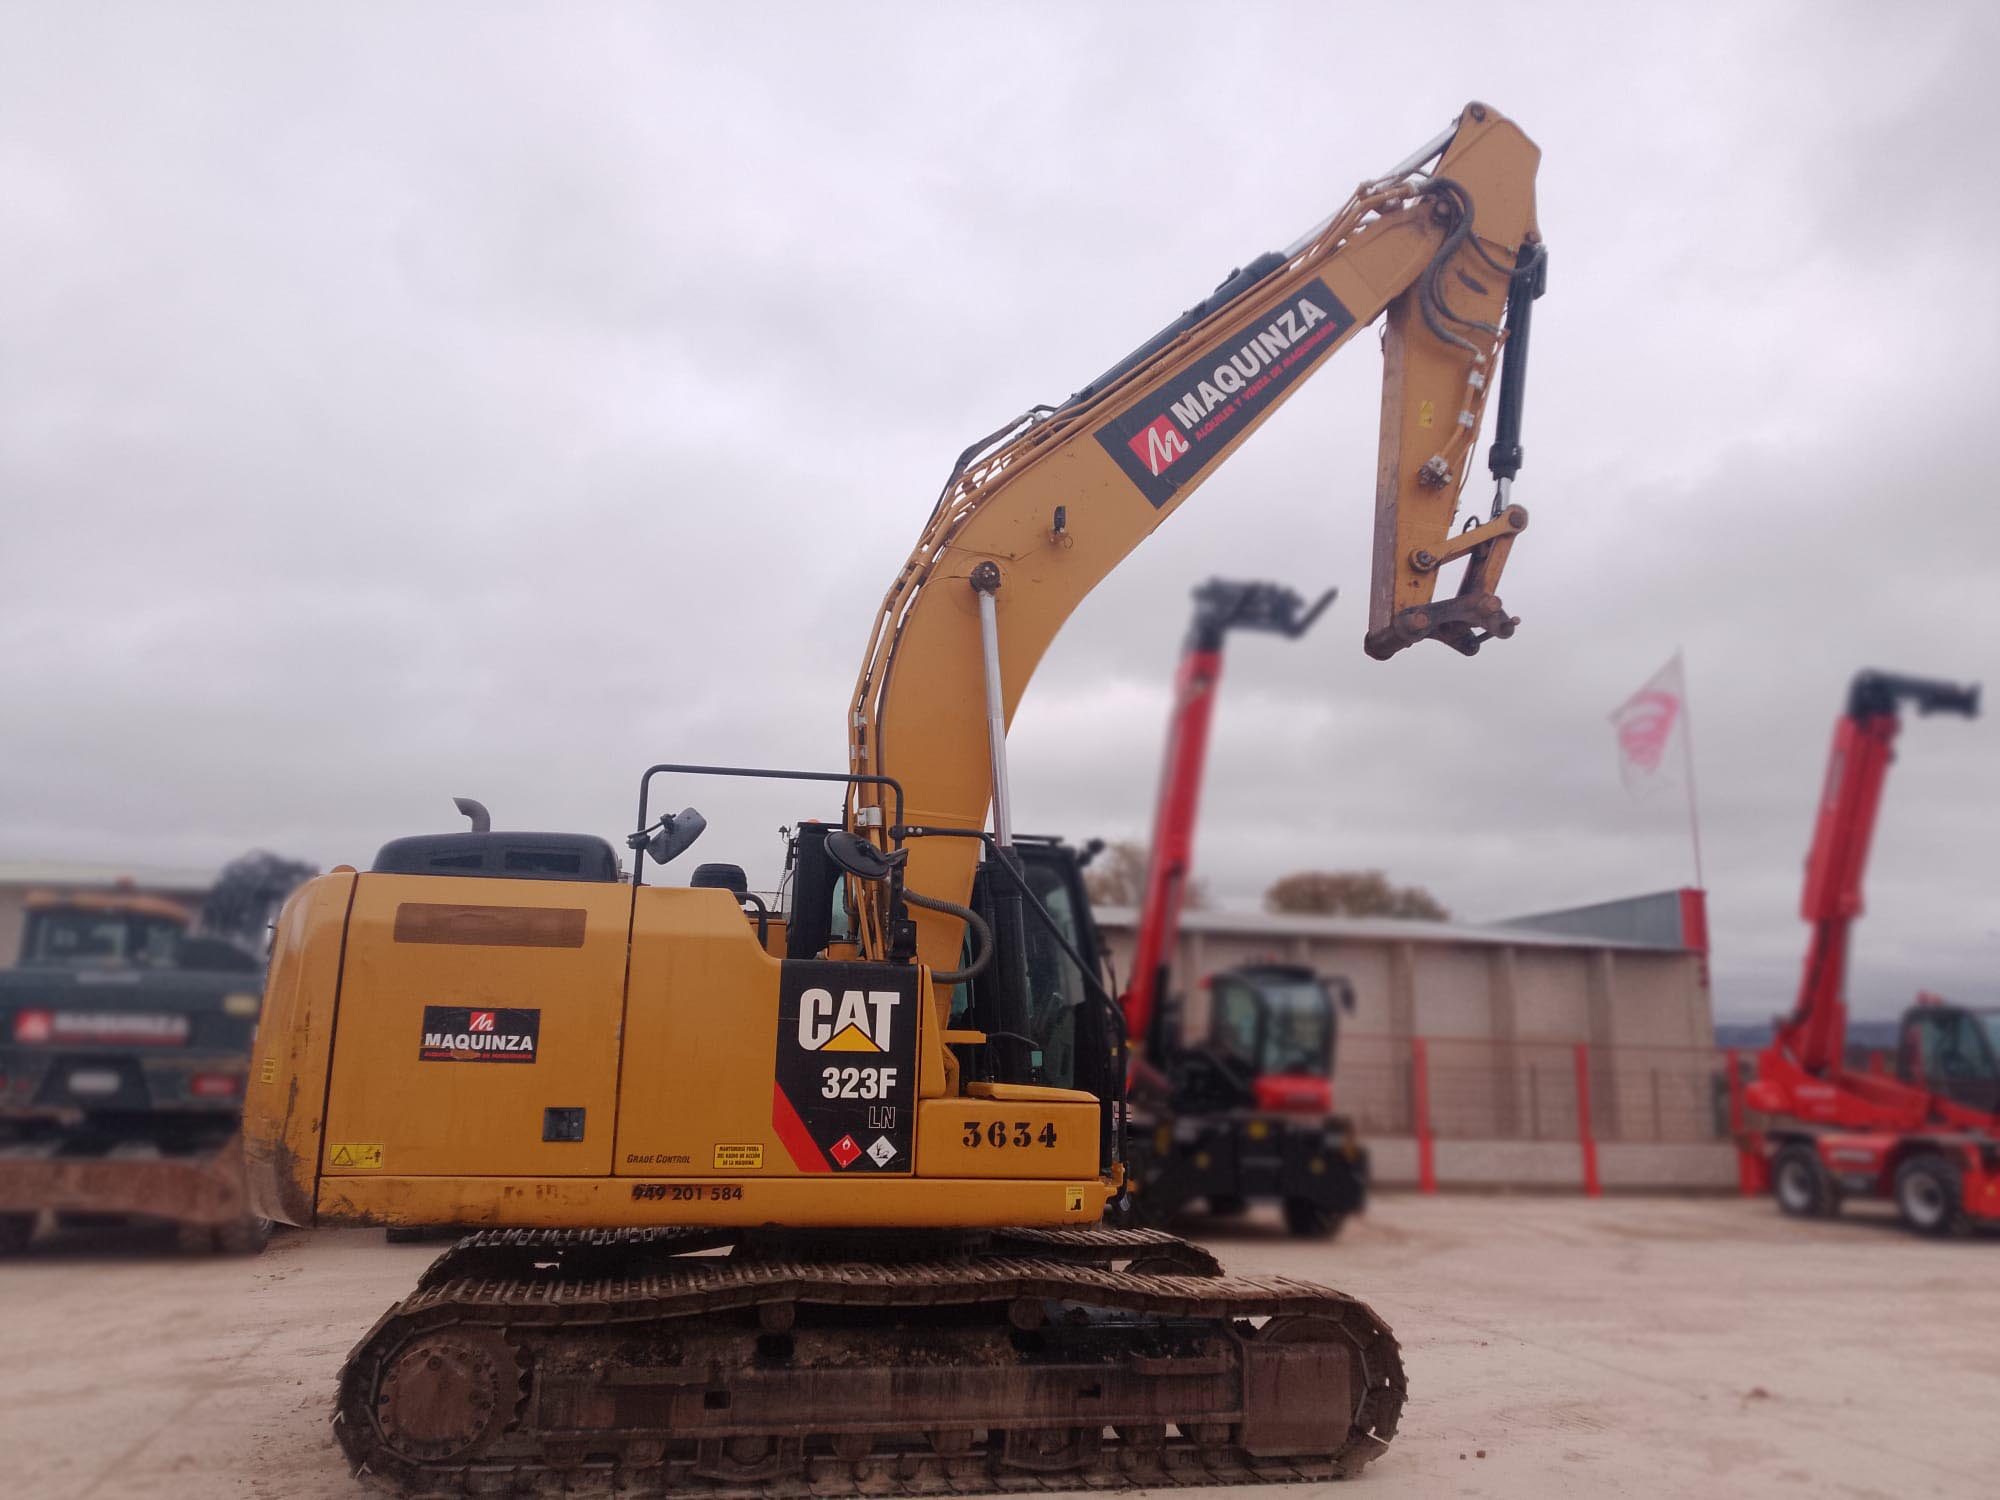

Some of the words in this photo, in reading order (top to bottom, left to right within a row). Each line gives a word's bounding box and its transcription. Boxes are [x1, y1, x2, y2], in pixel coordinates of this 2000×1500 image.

[1170, 298, 1327, 430] MAQUINZA
[798, 988, 900, 1053] CAT
[424, 1033, 533, 1051] MAQUINZA
[821, 1067, 897, 1100] 323F
[868, 1106, 896, 1129] LN
[963, 1121, 1057, 1148] 3634
[627, 1154, 654, 1164] GRADE
[656, 1154, 690, 1164] CONTROL
[671, 1187, 702, 1201] 201
[710, 1187, 743, 1201] 584
